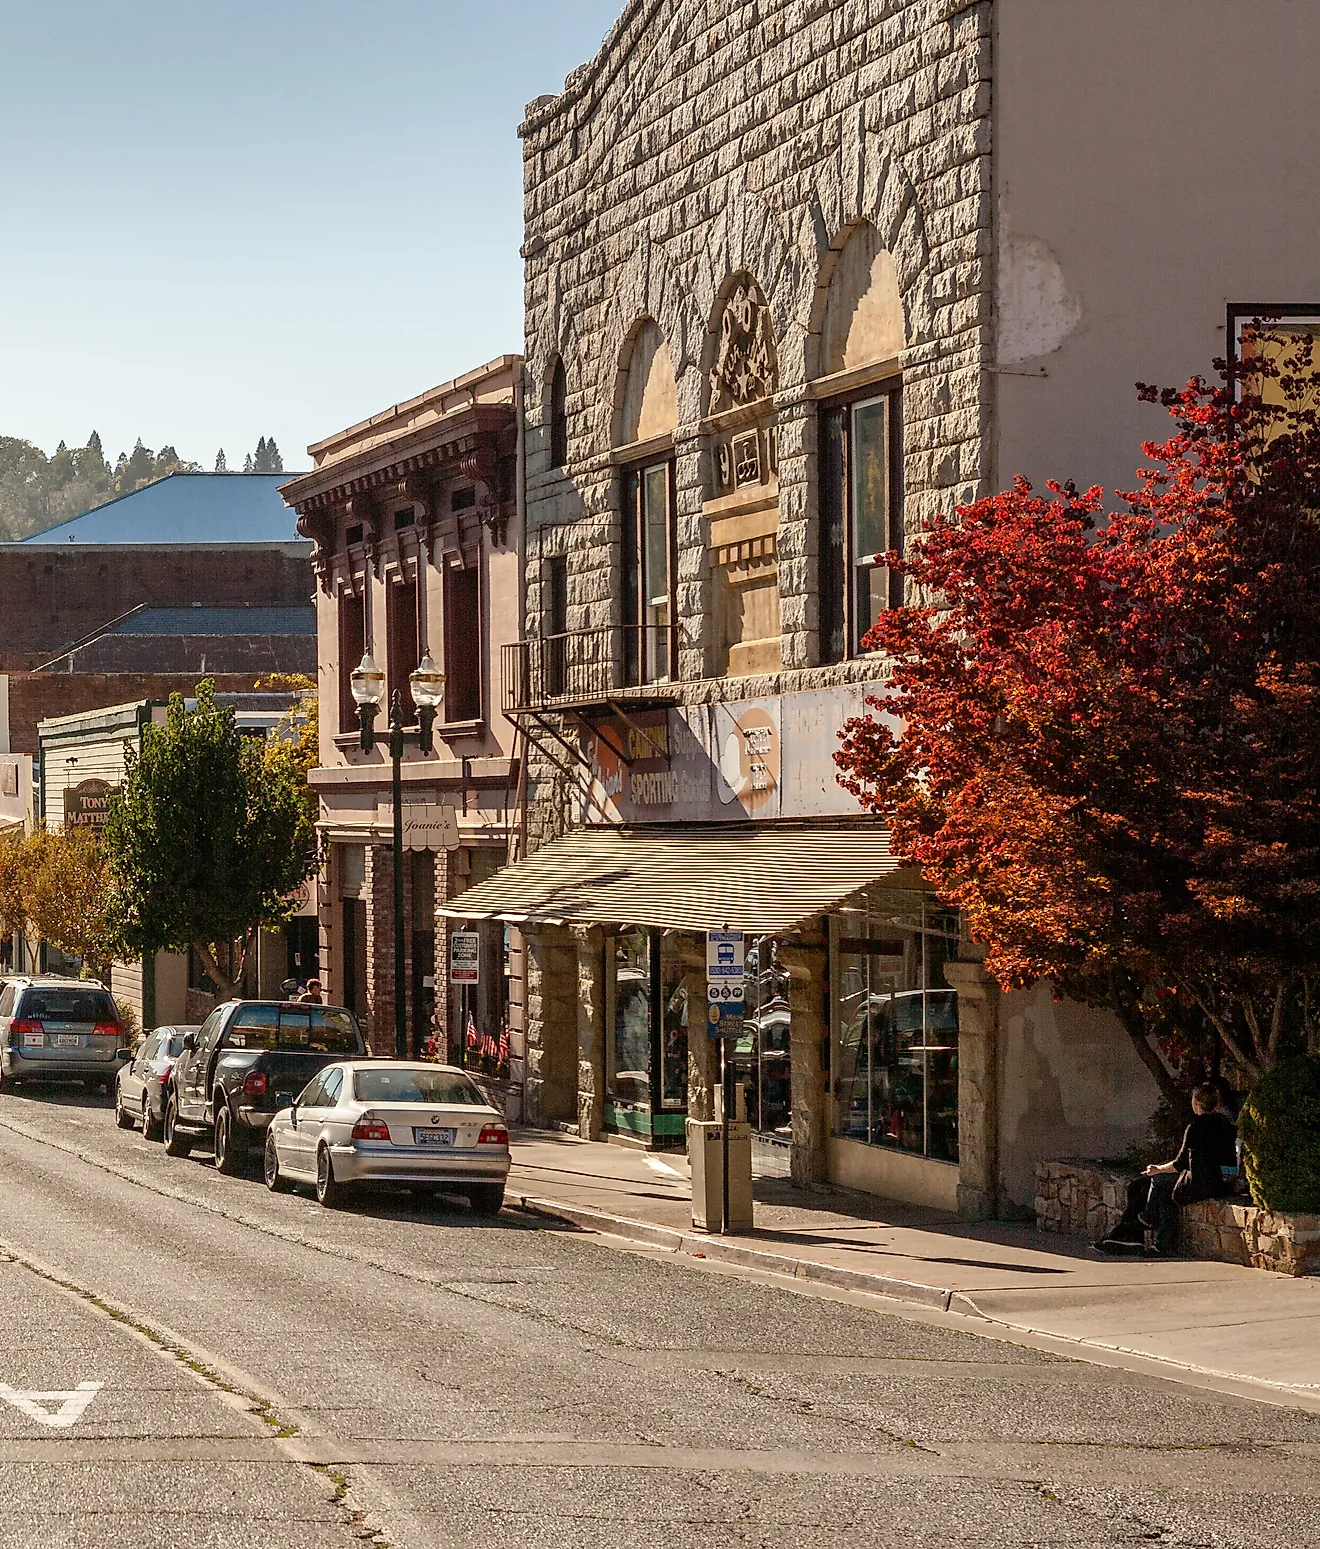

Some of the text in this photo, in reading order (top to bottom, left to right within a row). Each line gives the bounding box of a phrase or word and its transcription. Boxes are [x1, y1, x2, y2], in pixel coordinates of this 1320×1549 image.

[630, 771, 679, 805] SPORTING
[80, 796, 107, 808] TONY
[67, 811, 109, 824] MATTHE
[404, 820, 451, 833] Joanie's
